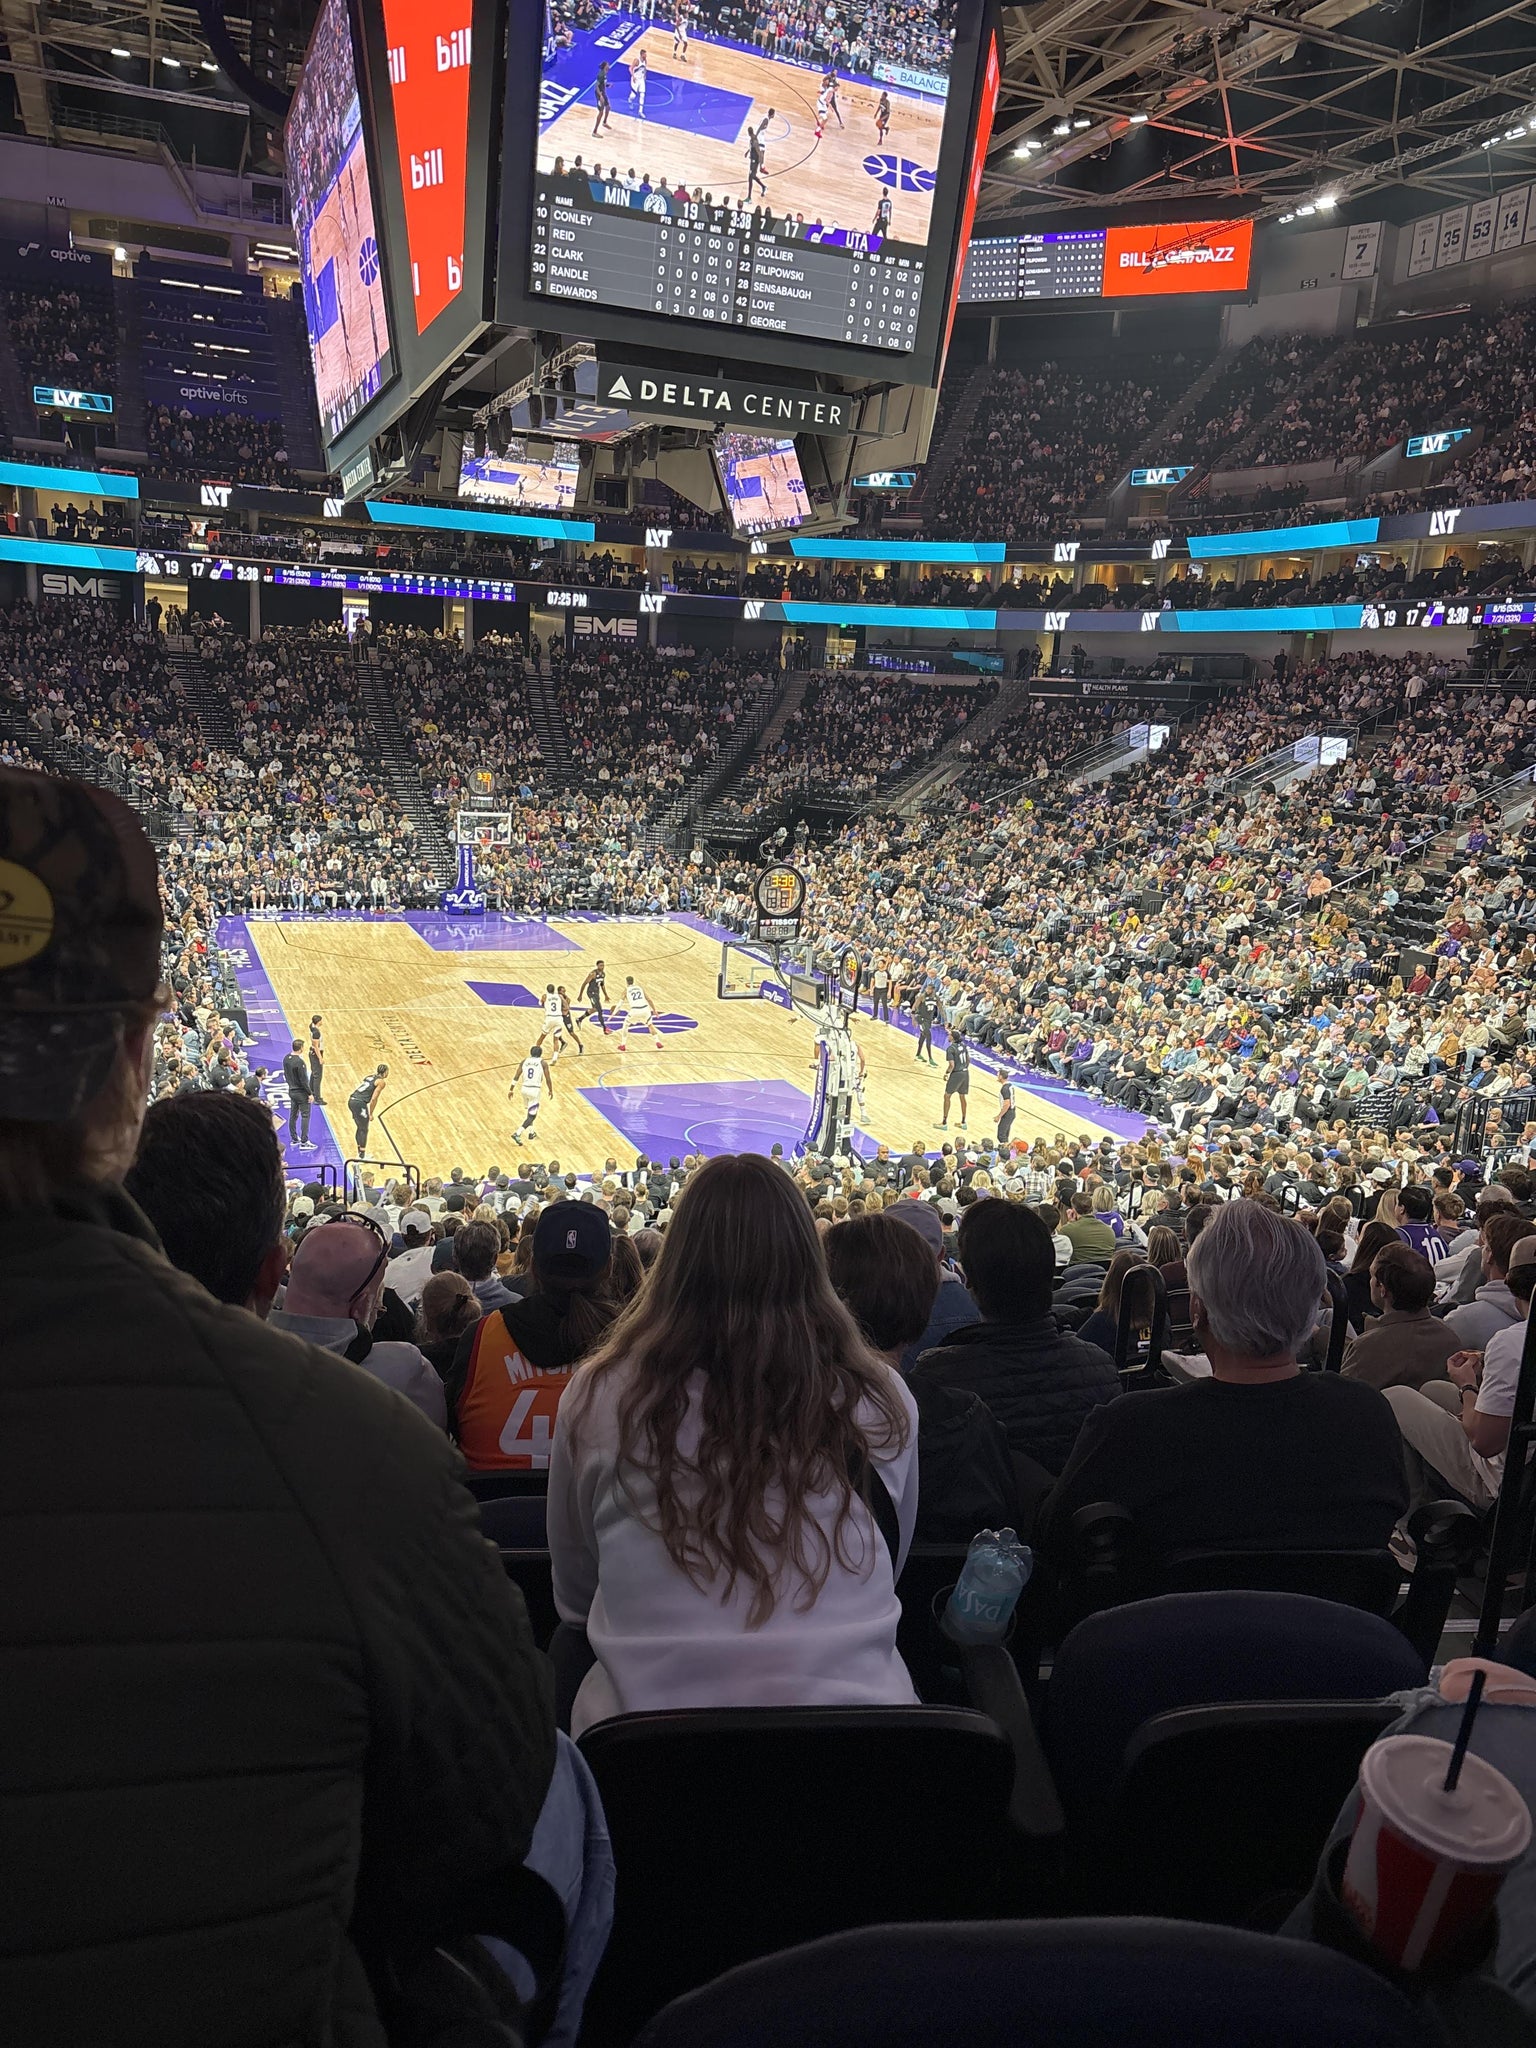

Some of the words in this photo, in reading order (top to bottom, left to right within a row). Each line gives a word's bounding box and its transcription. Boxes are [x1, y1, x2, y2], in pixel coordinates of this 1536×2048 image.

[386, 46, 406, 85] ill
[436, 27, 471, 72] bill
[774, 54, 824, 72] PACS
[901, 72, 947, 93] BALANCE
[410, 148, 444, 190] bill
[605, 187, 630, 207] MIN
[683, 203, 698, 220] 19
[730, 212, 752, 230] 3:38
[760, 218, 766, 230] 7
[784, 221, 799, 238] 17
[846, 232, 868, 252] UTA
[1472, 220, 1491, 240] 53
[1504, 210, 1518, 231] 14
[536, 208, 548, 218] 10
[554, 210, 592, 226] CONLEY
[661, 229, 667, 240] 0
[678, 232, 685, 243] 0
[694, 235, 701, 246] 0
[709, 238, 721, 250] 00
[727, 241, 734, 251] 0
[743, 244, 750, 254] 8
[757, 247, 793, 262] COLLIER
[853, 264, 860, 274] 0
[870, 267, 876, 276] 0
[885, 269, 891, 279] 2
[897, 271, 908, 282] 02
[914, 274, 920, 284] 0
[660, 216, 671, 225] PTS
[693, 222, 705, 230] AST
[710, 225, 721, 234] MIN
[728, 228, 736, 236] PF
[885, 256, 895, 265] AST
[1420, 238, 1426, 256] 1
[1443, 228, 1460, 248] 35
[50, 248, 92, 264] aptive
[1356, 243, 1368, 260] 7
[537, 226, 545, 236] 11
[553, 228, 575, 242] REID
[660, 248, 666, 257] 3
[678, 250, 683, 260] 1
[693, 253, 700, 263] 0
[708, 256, 718, 266] 01
[726, 259, 732, 269] 0
[739, 261, 750, 272] 22
[755, 264, 804, 282] FILIPOWSKI
[851, 280, 858, 291] 0
[868, 284, 873, 293] 1
[882, 286, 889, 296] 0
[895, 288, 904, 298] 01
[912, 291, 918, 301] 0
[534, 244, 546, 255] 22
[552, 247, 584, 262] CLARK
[658, 265, 665, 276] 0
[676, 269, 682, 278] 0
[692, 271, 698, 281] 0
[706, 274, 717, 285] 02
[725, 277, 730, 286] 1
[737, 278, 749, 289] 28
[753, 281, 811, 300] SENSABAUGH
[849, 297, 855, 307] 3
[865, 300, 872, 310] 0
[882, 303, 886, 312] 1
[893, 304, 903, 315] 01
[910, 307, 916, 317] 0
[533, 262, 545, 274] 30
[551, 266, 589, 281] RANDLE
[657, 283, 663, 293] 0
[674, 286, 681, 296] 0
[690, 289, 697, 299] 2
[704, 291, 716, 302] 08
[722, 294, 728, 304] 0
[736, 295, 748, 307] 42
[751, 299, 775, 311] LOVE
[848, 314, 854, 324] 0
[864, 317, 870, 327] 0
[878, 319, 885, 329] 0
[890, 321, 901, 332] 02
[907, 324, 913, 334] 0
[535, 281, 541, 291] 5
[550, 283, 597, 300] EDWARDS
[656, 300, 662, 310] 6
[673, 304, 680, 313] 3
[689, 306, 695, 315] 0
[703, 308, 714, 319] 08
[721, 311, 727, 320] 0
[737, 313, 743, 323] 3
[750, 315, 787, 330] GEORGE
[845, 331, 852, 340] 8
[862, 333, 868, 343] 2
[877, 336, 882, 344] 1
[888, 337, 899, 347] 08
[905, 339, 911, 349] 0
[180, 386, 220, 403] aptive
[222, 387, 248, 404] lofts
[640, 380, 731, 411] DELTA
[744, 394, 841, 425] CENTER
[164, 560, 179, 574] 19
[191, 562, 204, 577] 17
[237, 566, 258, 581] 3:38
[42, 573, 120, 599] SME
[547, 591, 572, 606] 07:25
[572, 593, 587, 608] PM
[574, 615, 638, 636] SME
[1384, 610, 1397, 626] 19
[1406, 609, 1419, 625] 17
[1446, 607, 1468, 625] 3:38
[772, 874, 795, 888] 3:38
[631, 991, 642, 1000] 22
[550, 1002, 557, 1012] 3
[960, 1052, 966, 1064] 11
[528, 1068, 534, 1079] 8
[809, 1094, 820, 1137] AMERICA
[1422, 1237, 1446, 1266] 10
[499, 1389, 553, 1469] 4
